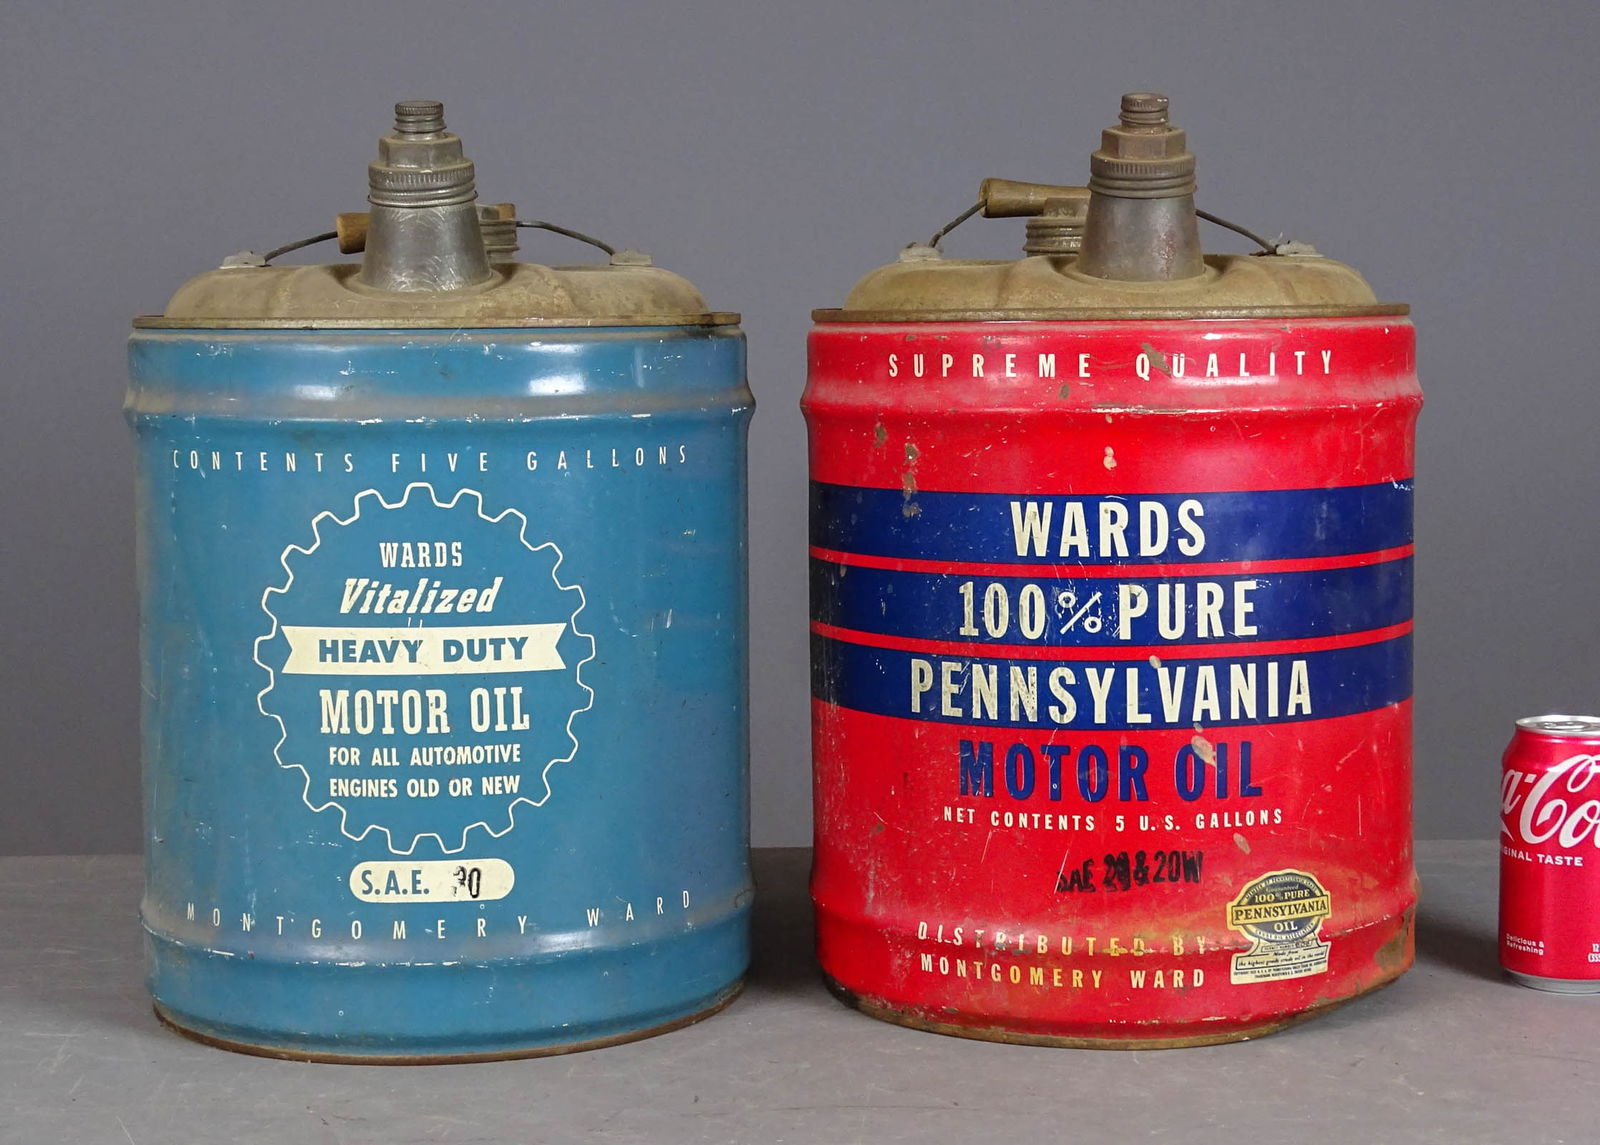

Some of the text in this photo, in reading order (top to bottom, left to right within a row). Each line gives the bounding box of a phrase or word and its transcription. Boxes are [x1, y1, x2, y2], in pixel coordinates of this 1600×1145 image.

[888, 349, 1333, 381] SUPREME QUALITY
[173, 444, 687, 473] CONTENTS FIVE GALLONS
[1011, 498, 1206, 558] WARDS
[379, 542, 463, 569] WARDS
[339, 577, 503, 614] Vitalized
[1120, 580, 1258, 640] PURE
[319, 636, 529, 664] HEAVY DUTY
[911, 659, 1312, 724] PENNSYLVANIA
[319, 686, 530, 735] MOTOR OIL
[329, 744, 521, 766] FOR ALL AUTOMOTIVE
[960, 739, 1263, 802] MOTOR OIL
[329, 774, 521, 798] ENGINES OLD OR NEW
[943, 806, 975, 823] NET
[991, 810, 1095, 831] CONTENTS
[1116, 814, 1125, 832] 5
[1196, 809, 1283, 830] GALLONS
[1536, 853, 1584, 867] TASTE
[361, 869, 430, 896] S.A.E.
[1284, 889, 1310, 900] PURE
[187, 890, 690, 941] MONTGOMERY WARD
[1234, 899, 1327, 921] PENNSYLVANIA
[917, 921, 1207, 956] DISTRIBUTED BY
[1274, 922, 1298, 932] OIL
[921, 953, 1102, 990] MONTGOMERY
[1130, 966, 1205, 989] WARD
